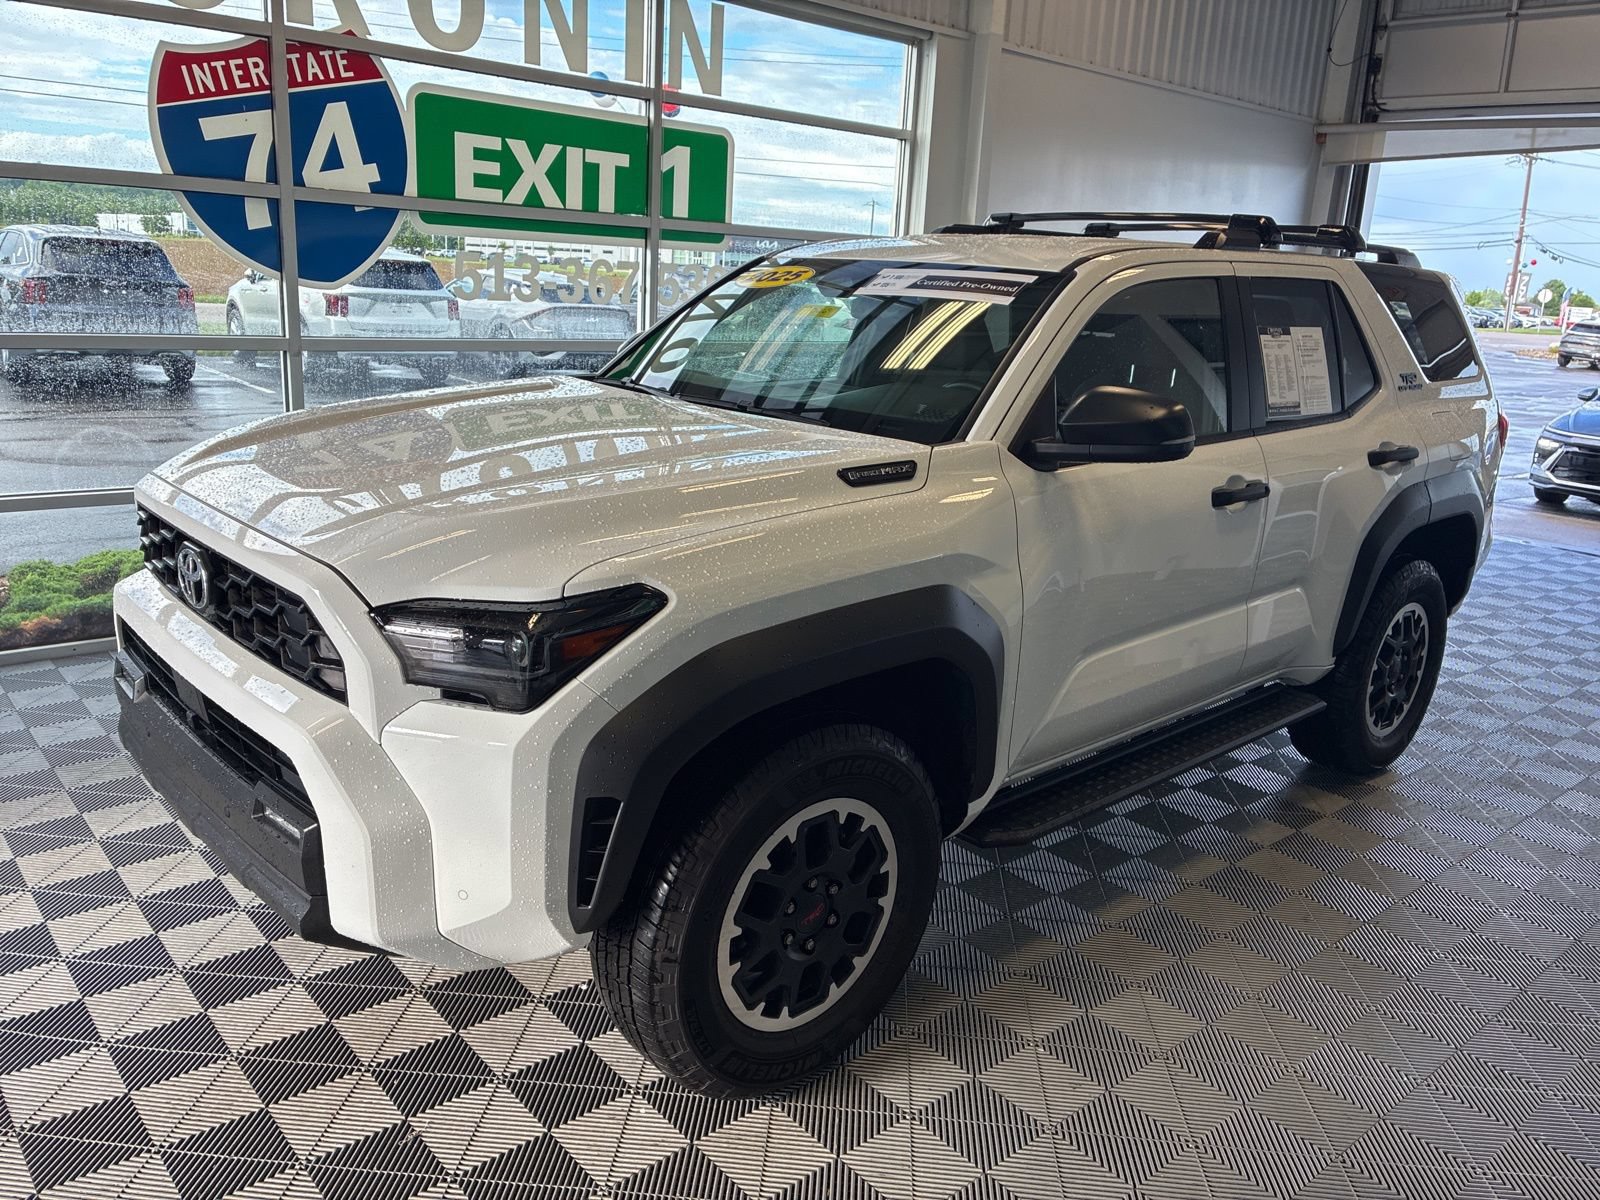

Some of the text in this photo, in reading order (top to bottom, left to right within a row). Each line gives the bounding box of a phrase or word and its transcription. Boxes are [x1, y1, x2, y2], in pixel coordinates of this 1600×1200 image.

[181, 49, 354, 95] INTERTATE
[198, 101, 381, 231] 74
[454, 131, 691, 218] EXIT 1
[916, 278, 1018, 292] Certified Pre-Owned
